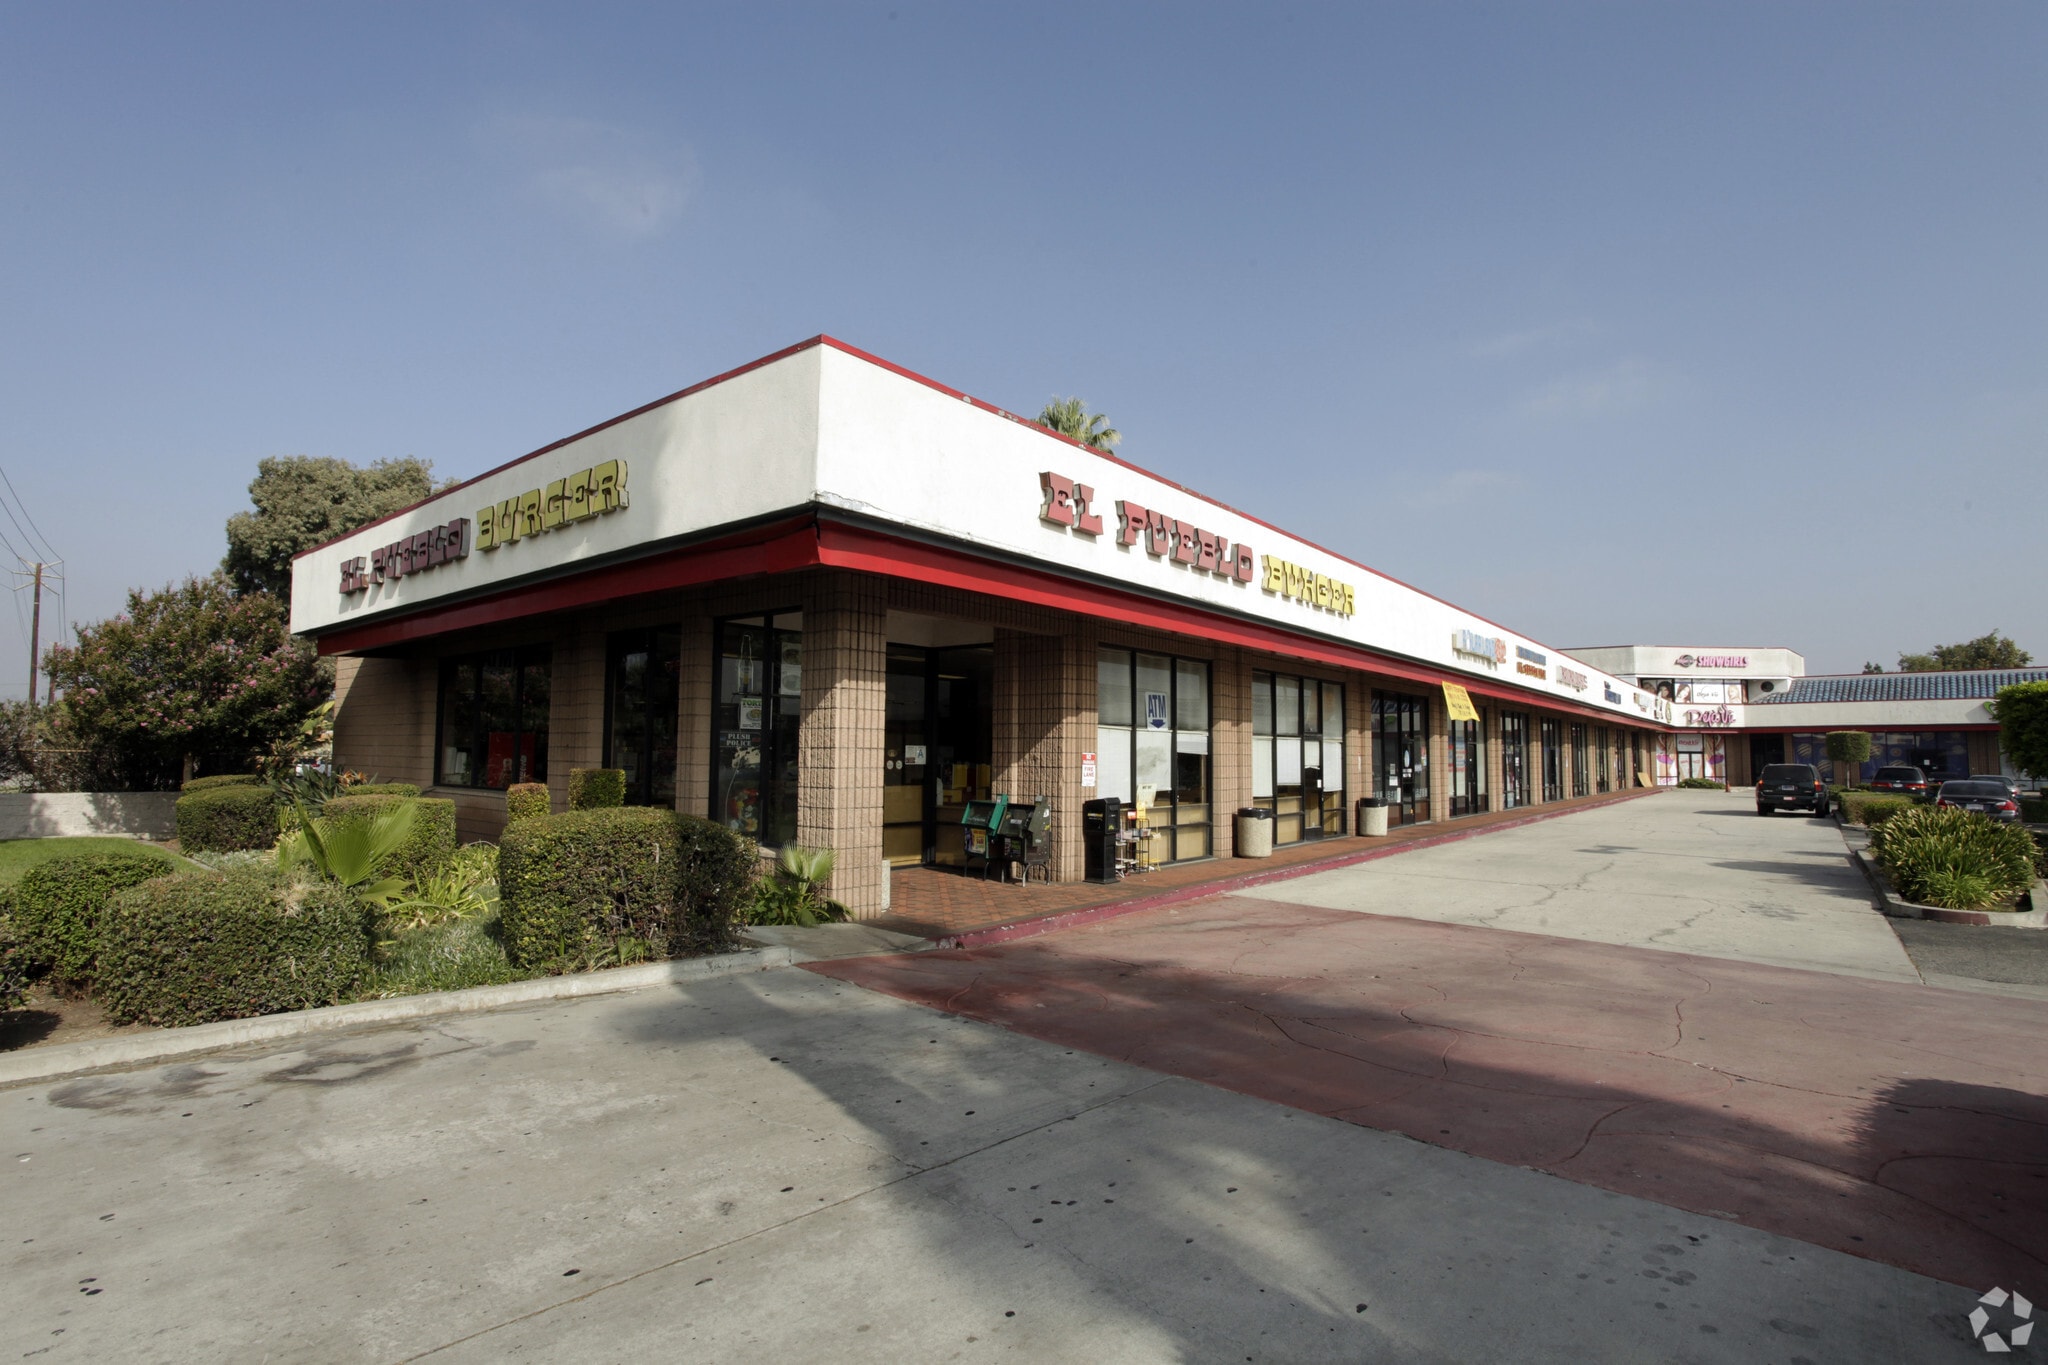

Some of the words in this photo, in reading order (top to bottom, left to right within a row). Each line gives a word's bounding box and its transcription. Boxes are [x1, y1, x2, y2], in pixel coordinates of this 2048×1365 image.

[340, 556, 369, 595] EL
[370, 517, 471, 585] PUEBLO
[476, 459, 630, 552] BURGER
[1039, 471, 1104, 536] EL
[1115, 500, 1254, 583] PUEBLO
[1260, 554, 1357, 616] BURGER
[1697, 655, 1749, 668] SHOWGIRLS
[1148, 694, 1167, 718] ATM
[918, 749, 924, 758] A
